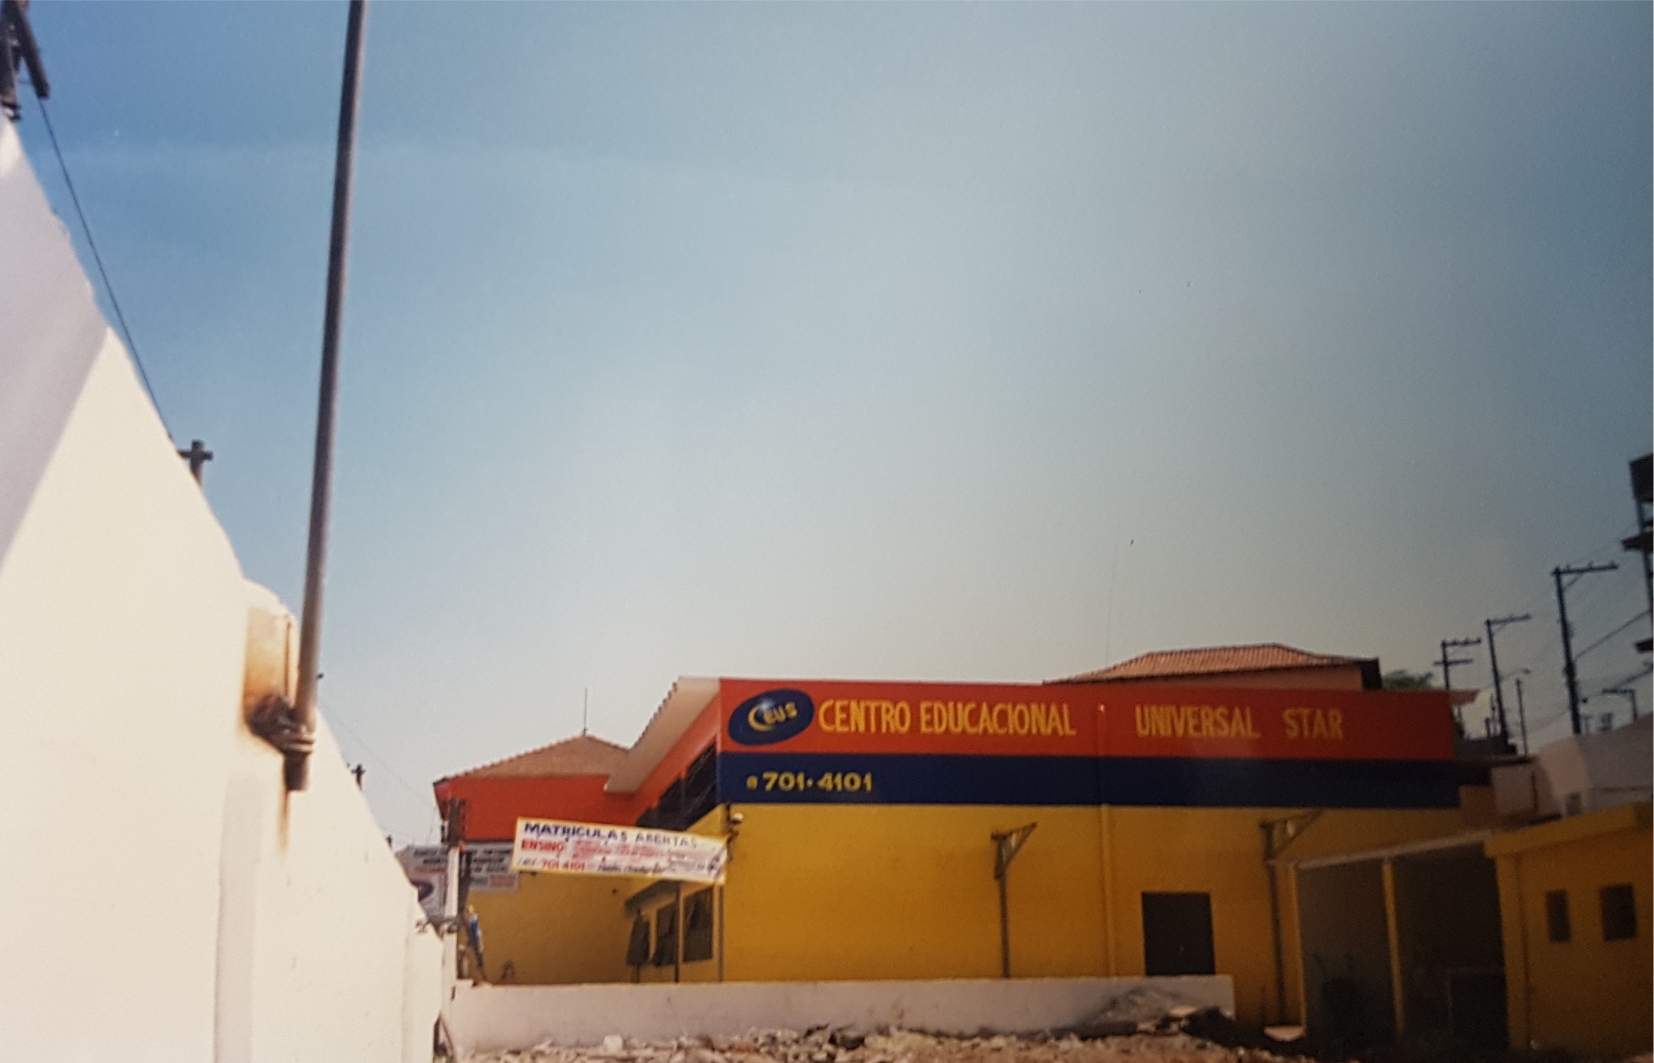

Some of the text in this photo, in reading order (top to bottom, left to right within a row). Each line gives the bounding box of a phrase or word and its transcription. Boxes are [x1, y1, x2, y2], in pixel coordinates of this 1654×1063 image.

[818, 699, 1344, 739] CENTRO EDUCACIONAL UNIVERSAL STAR
